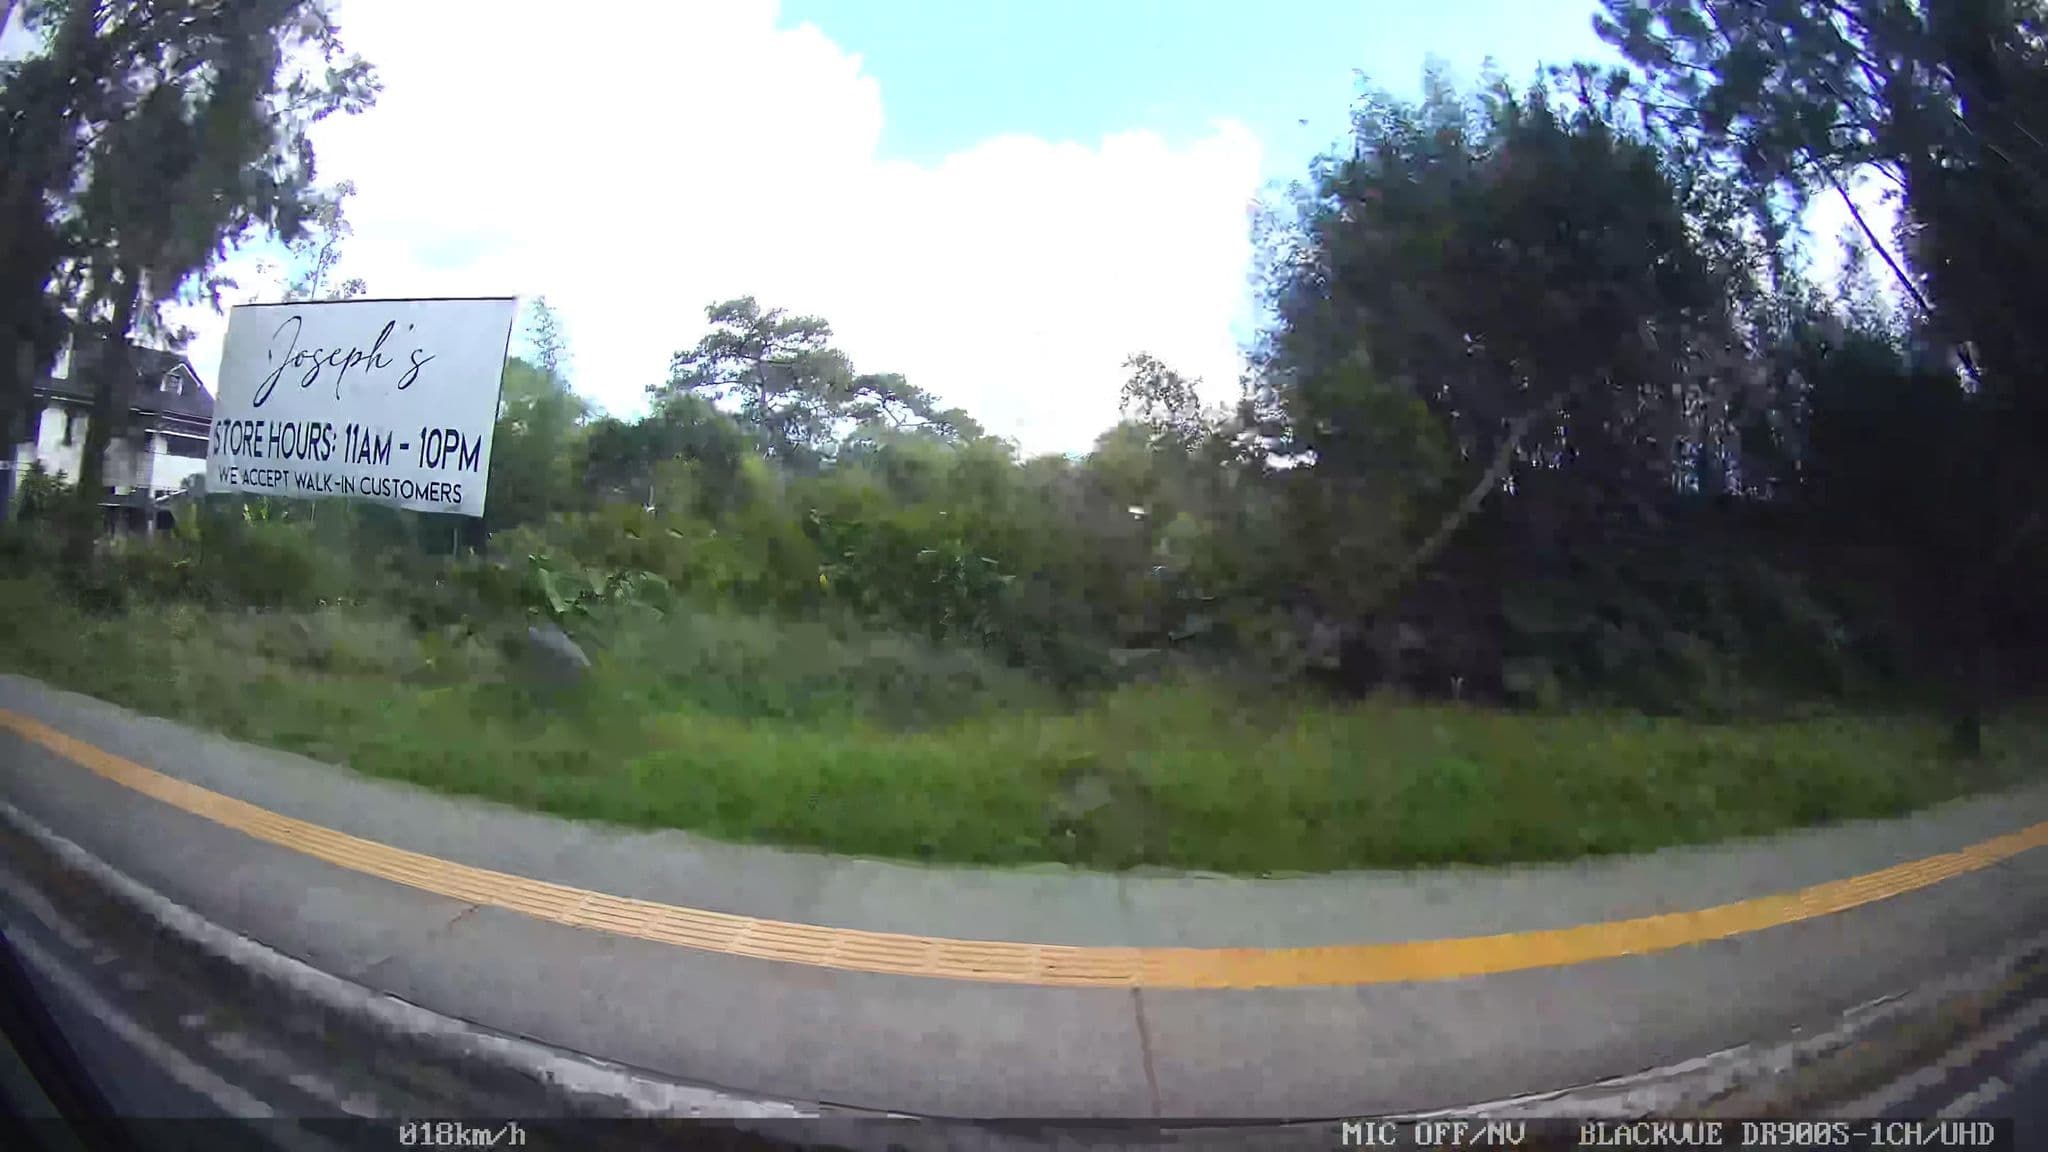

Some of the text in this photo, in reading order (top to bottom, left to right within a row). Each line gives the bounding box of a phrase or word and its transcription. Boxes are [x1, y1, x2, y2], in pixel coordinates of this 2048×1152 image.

[253, 315, 436, 407] Joseph's
[213, 419, 482, 473] STORE HOURS: 11AM - 10PM
[218, 465, 462, 504] WE ACCEPT WALK-IN CUSTOMERS
